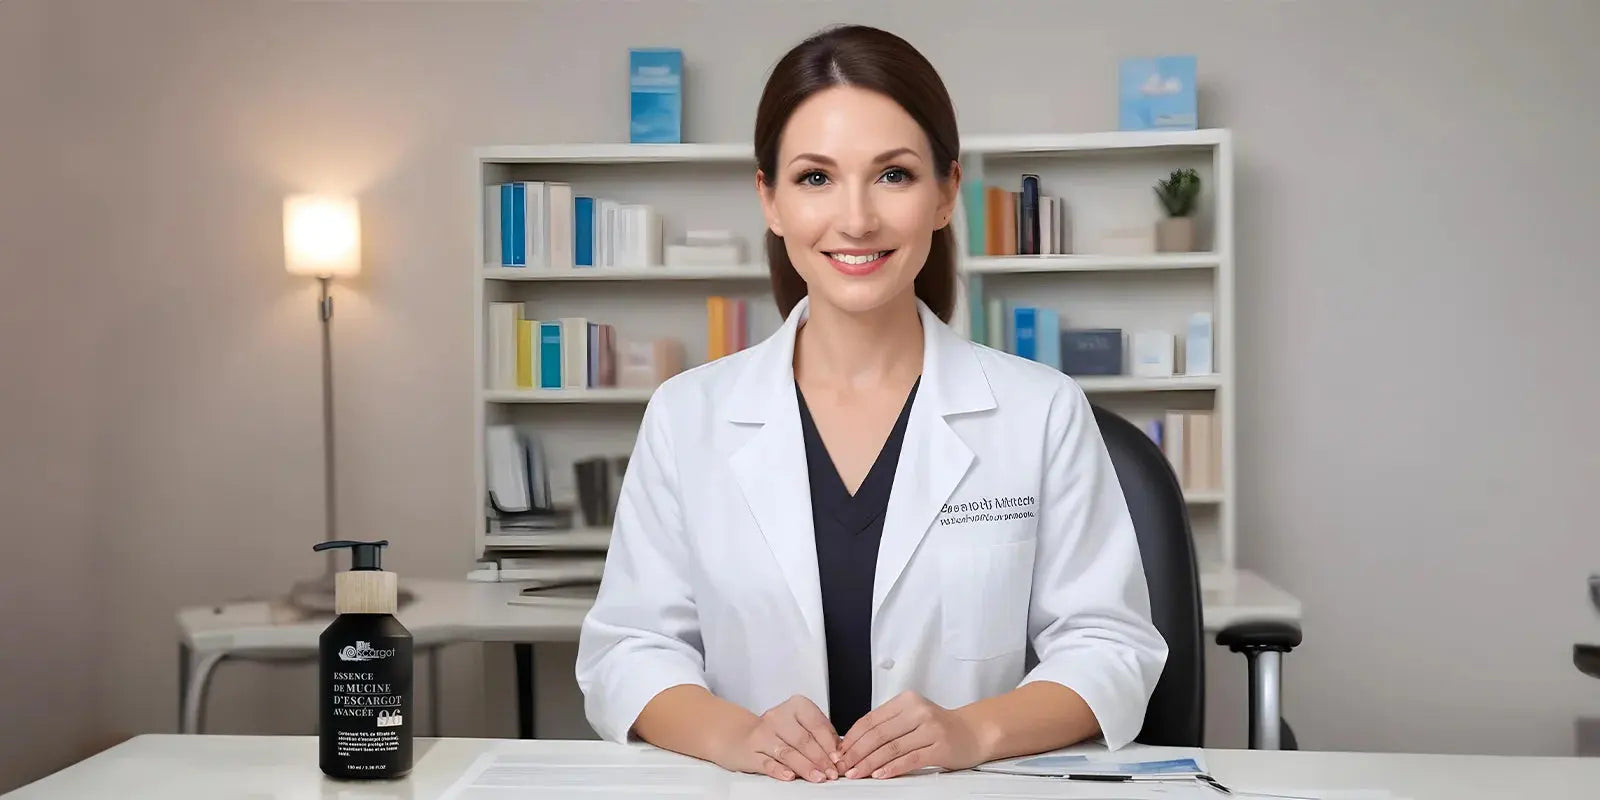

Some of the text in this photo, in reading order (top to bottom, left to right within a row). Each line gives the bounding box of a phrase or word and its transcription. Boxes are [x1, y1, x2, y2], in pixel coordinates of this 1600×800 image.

[333, 672, 374, 680] ESSENCE
[333, 683, 391, 693] DE MUCINE
[333, 695, 402, 705] D'ESCARGOT
[333, 706, 374, 717] AVANCÉE
[378, 708, 401, 725] 96
